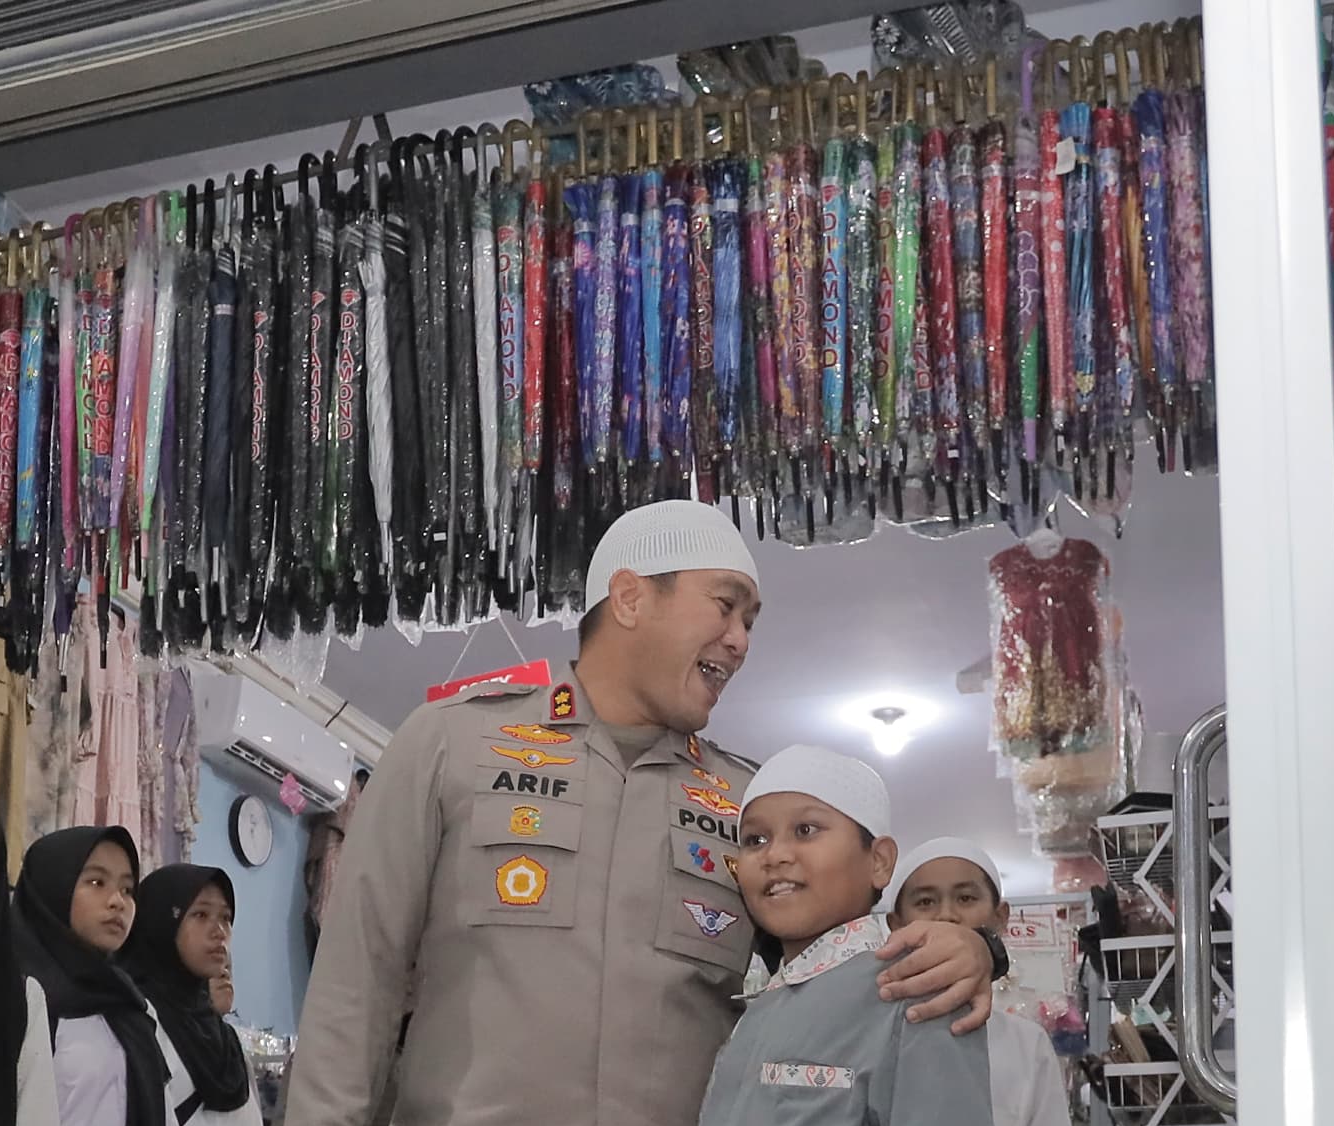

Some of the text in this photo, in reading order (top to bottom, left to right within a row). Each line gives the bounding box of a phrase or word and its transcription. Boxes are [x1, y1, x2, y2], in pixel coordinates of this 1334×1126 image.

[499, 254, 515, 401] DIAMOND
[822, 212, 840, 368] DIAMOND
[875, 219, 893, 379] DIAMOND
[97, 319, 111, 456] DIAMOND
[339, 312, 355, 440] DIAMOND
[492, 771, 569, 797] ARIF
